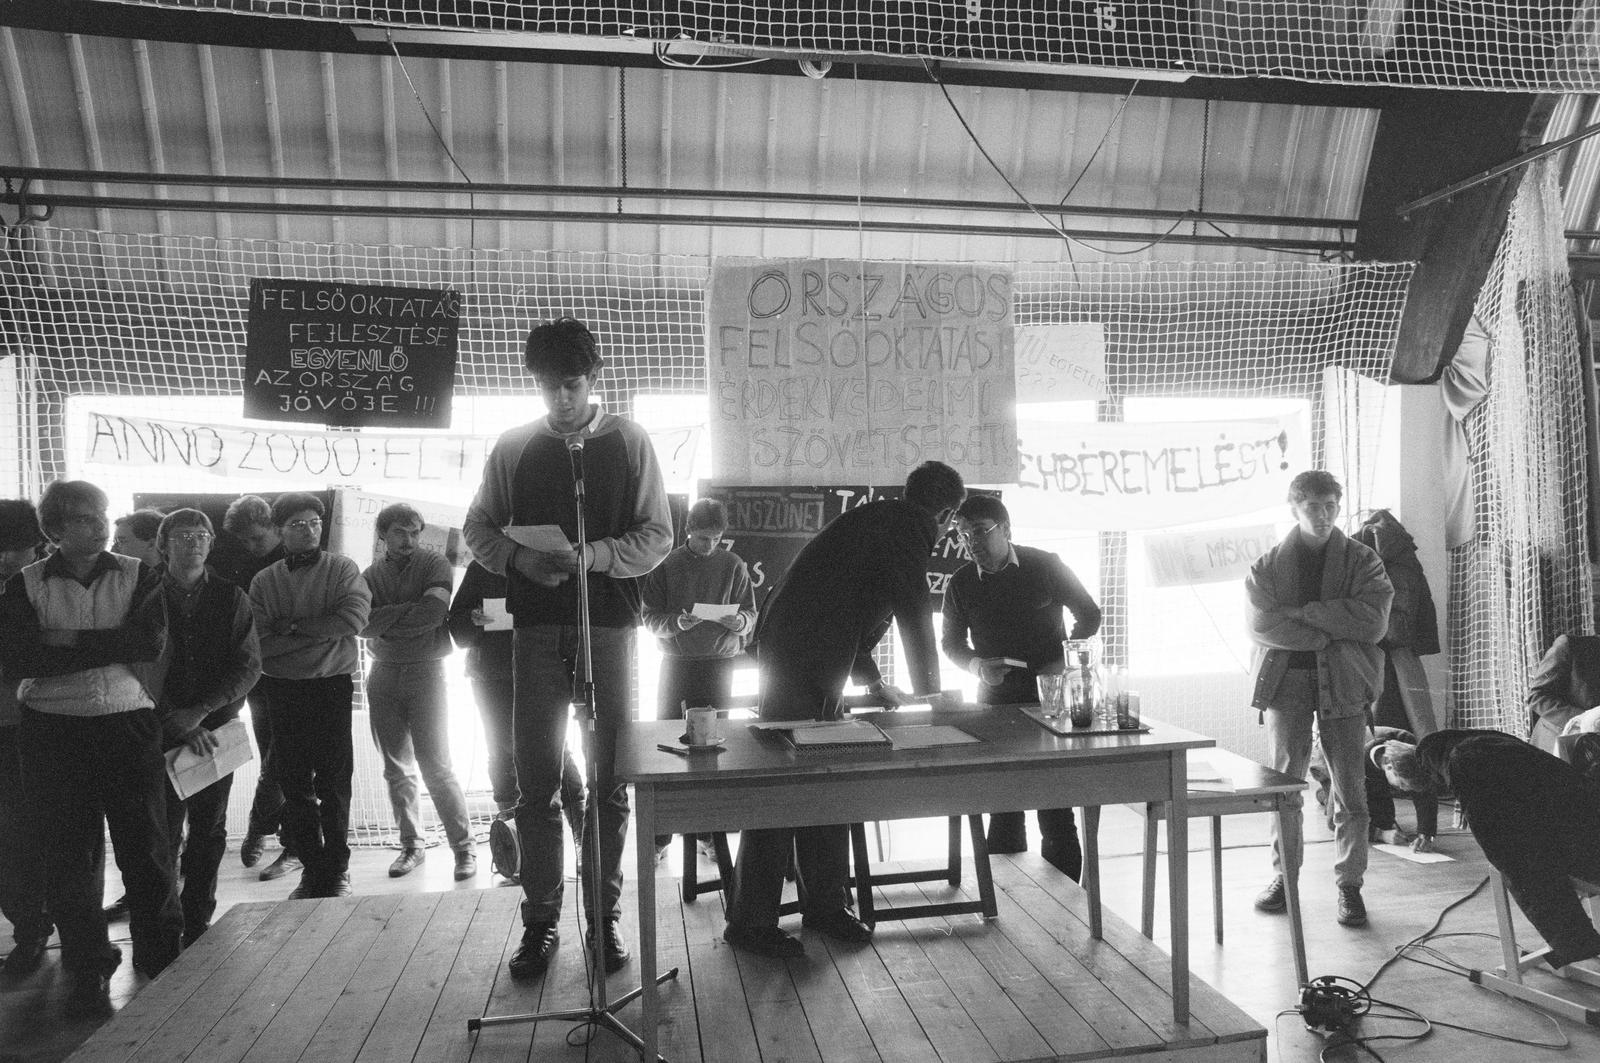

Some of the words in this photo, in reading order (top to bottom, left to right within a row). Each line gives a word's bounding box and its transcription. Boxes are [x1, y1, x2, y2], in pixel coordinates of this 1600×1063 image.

[748, 266, 1009, 322] ORSZÁGOS
[289, 322, 449, 346] FEJLESZTÉSE
[254, 368, 292, 387] AZ
[300, 372, 414, 392] ORSZÁG
[89, 411, 225, 467] ANNO
